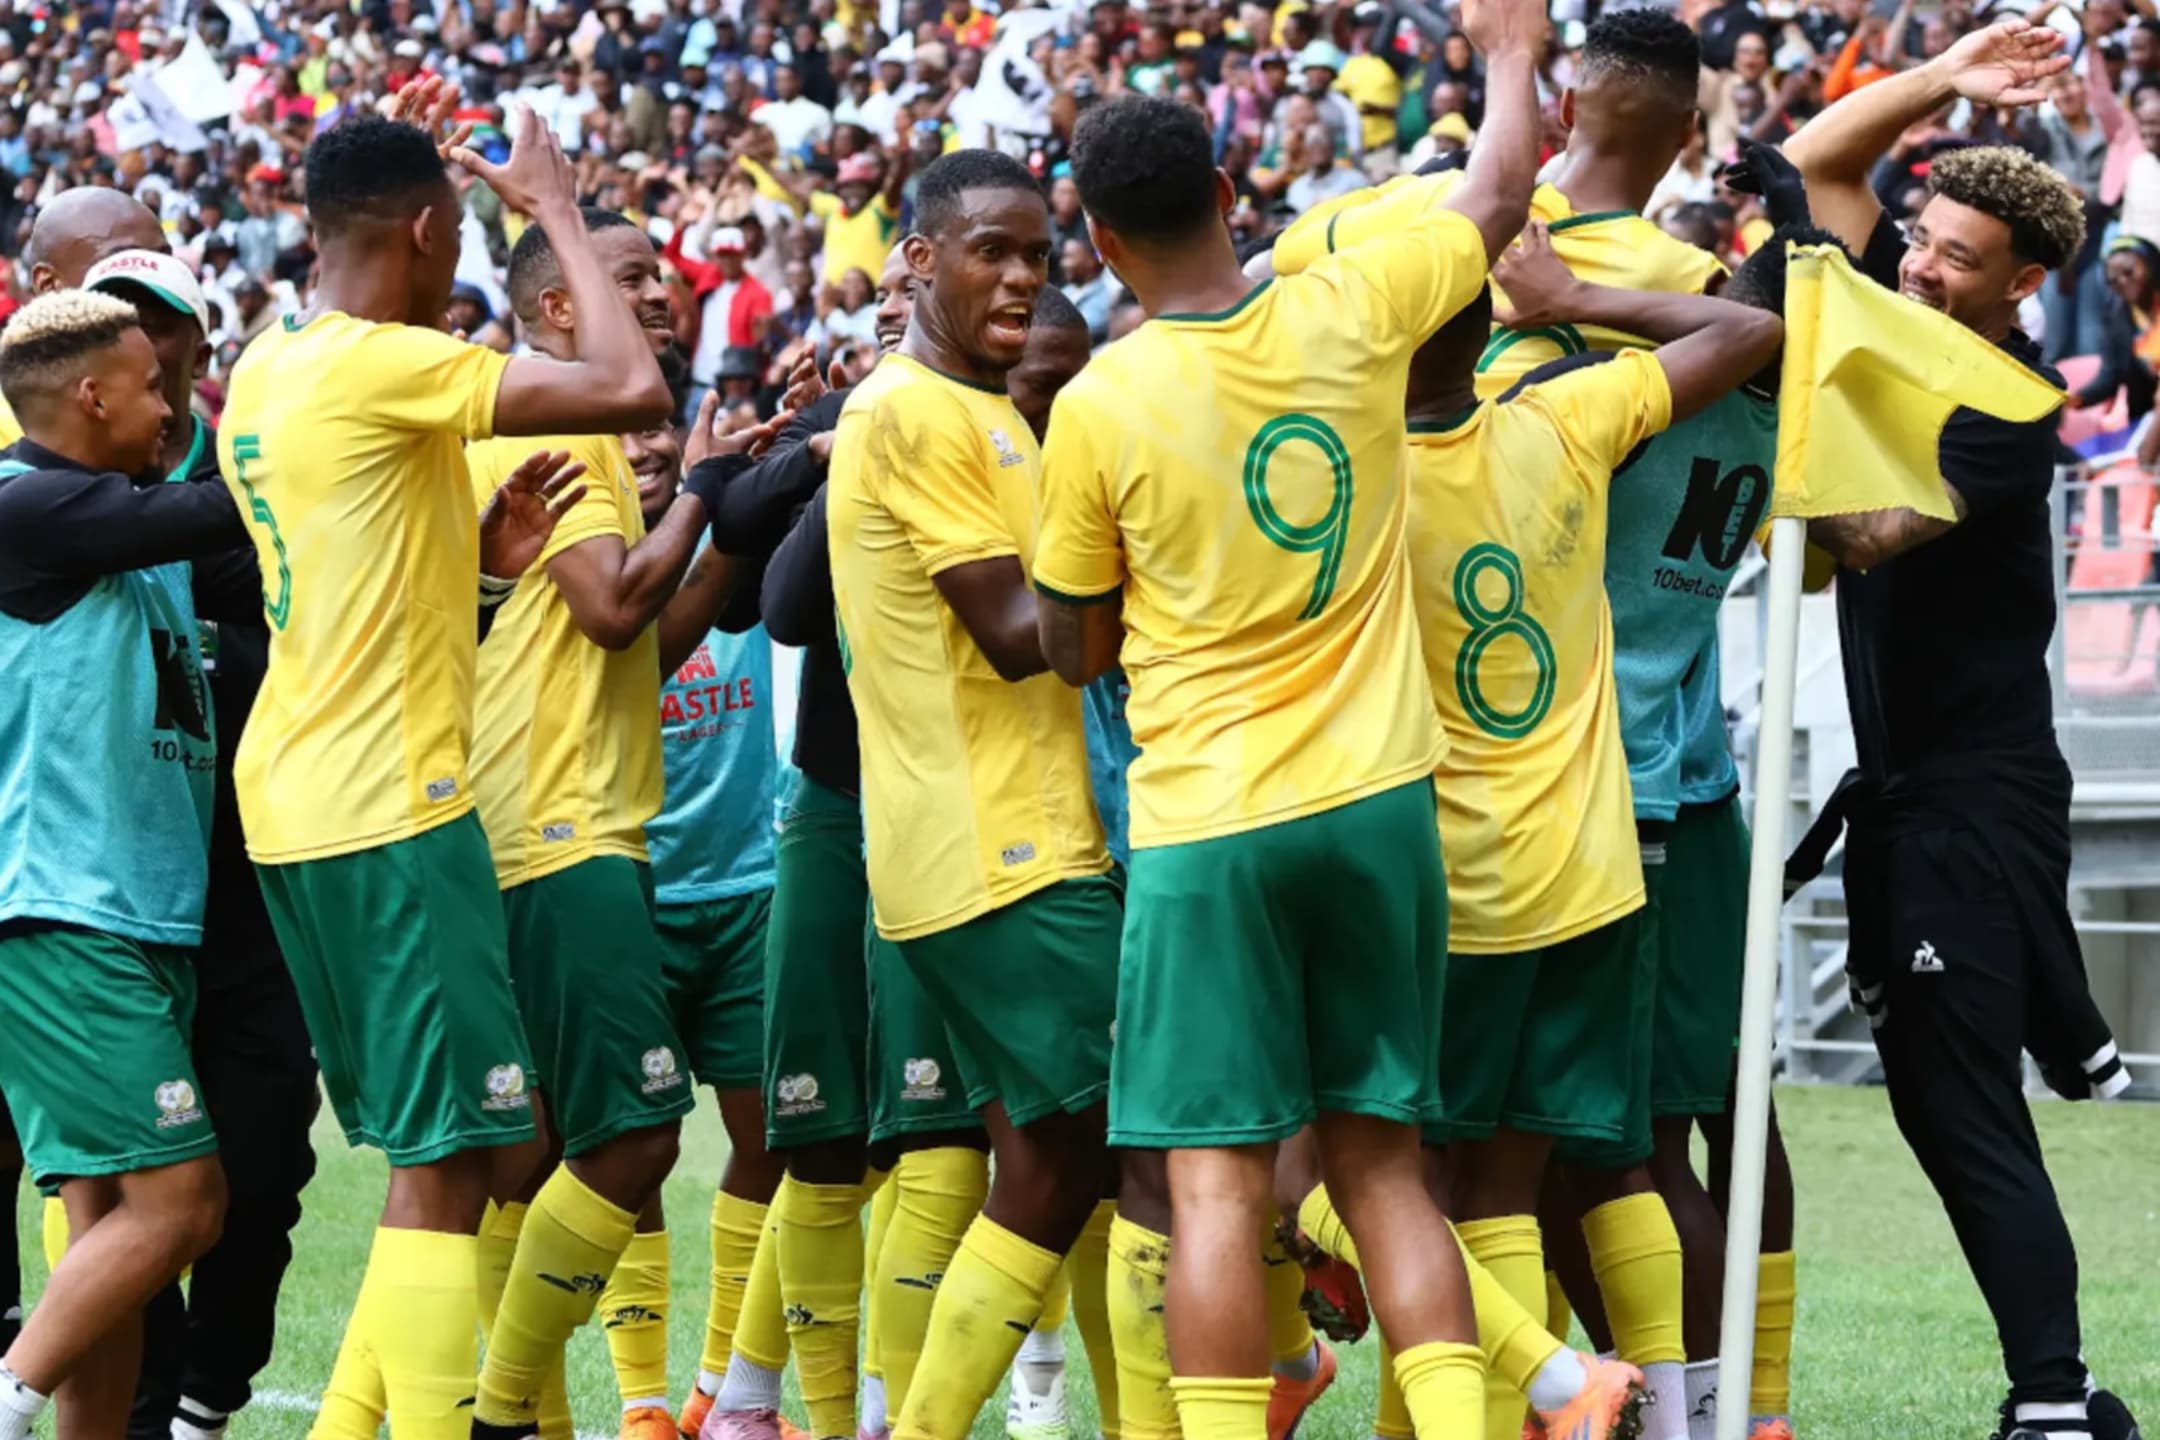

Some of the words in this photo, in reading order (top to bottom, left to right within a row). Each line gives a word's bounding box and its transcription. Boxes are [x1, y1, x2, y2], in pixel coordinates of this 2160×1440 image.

[233, 434, 291, 631] 5
[1242, 412, 1353, 621] 9
[661, 676, 755, 724] ASTLE
[1453, 541, 1557, 738] 8
